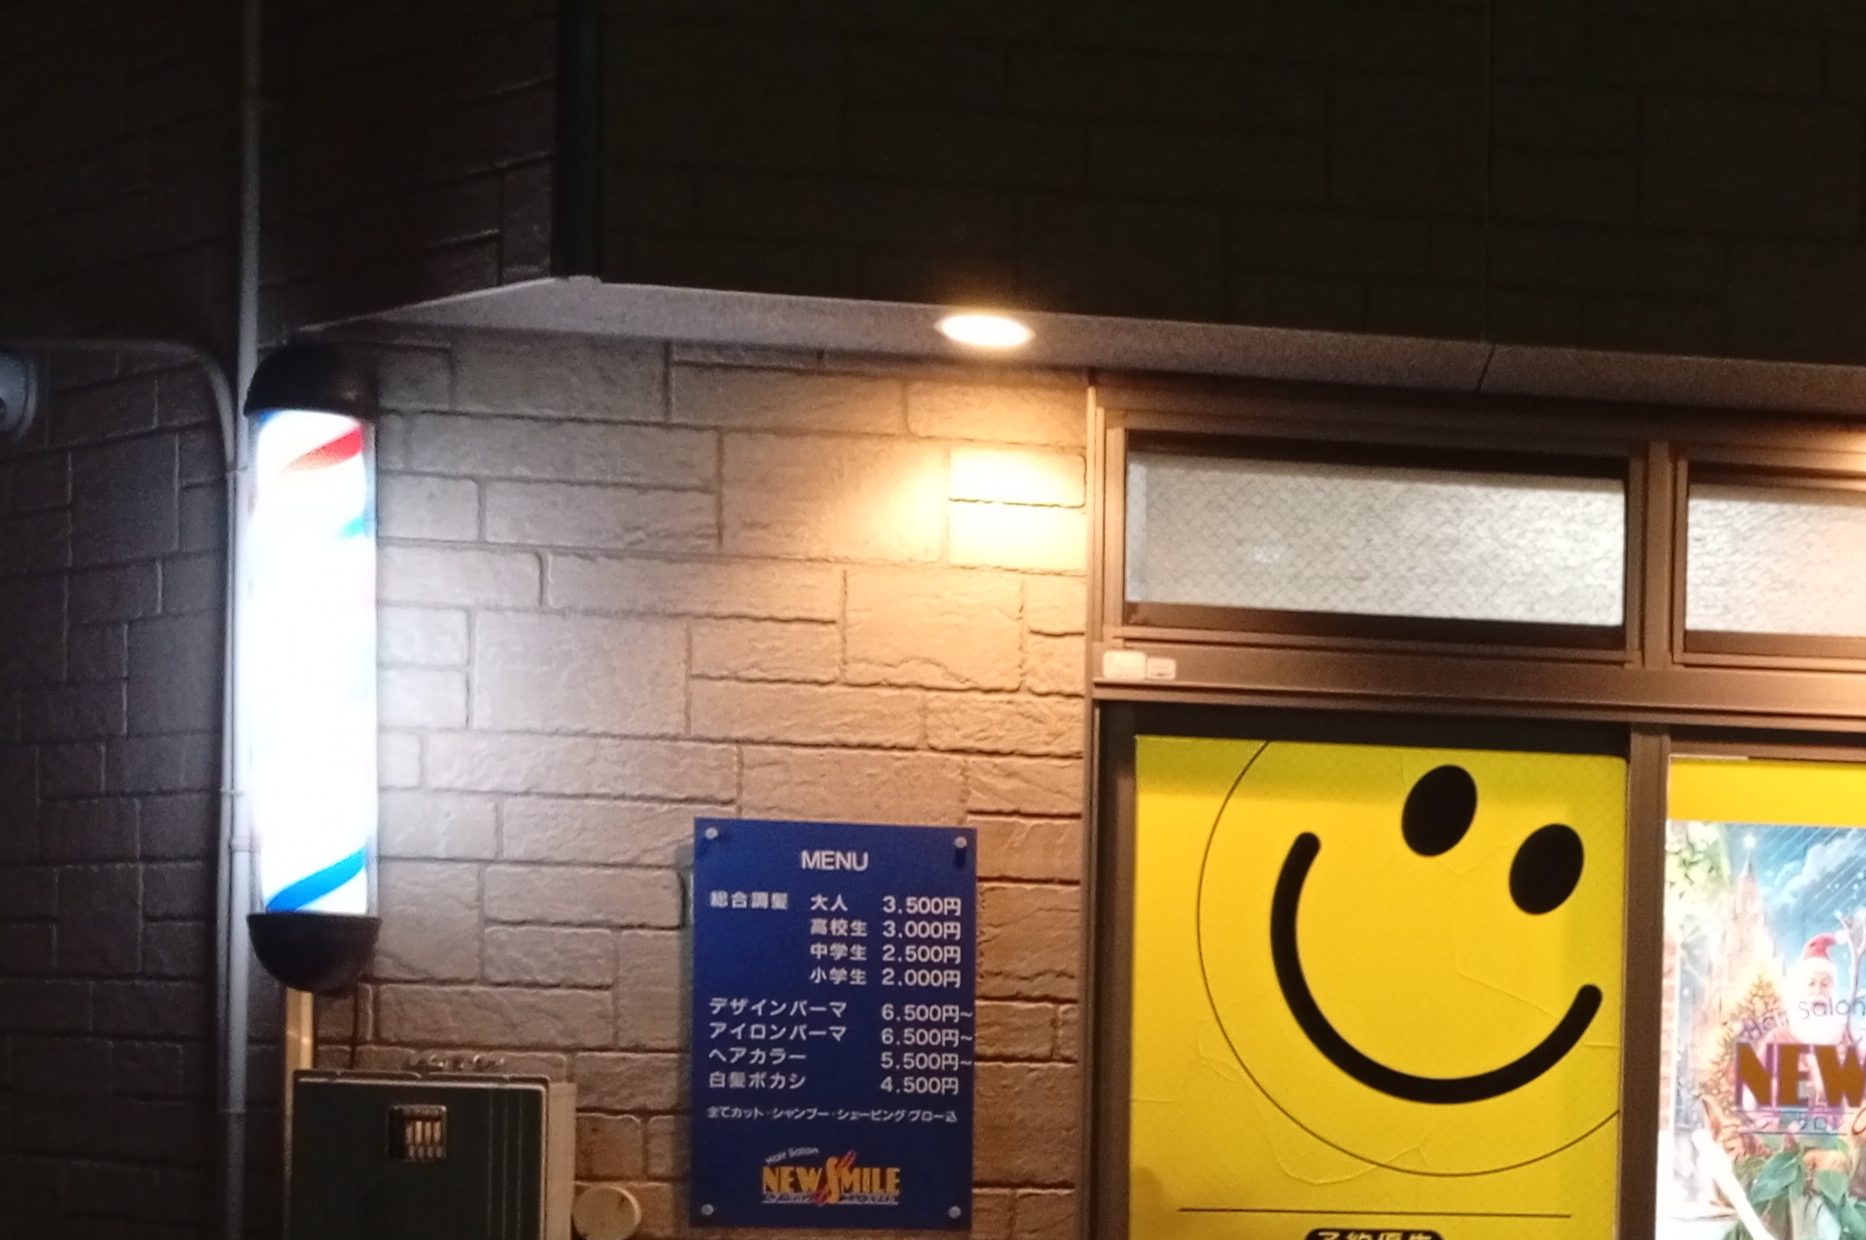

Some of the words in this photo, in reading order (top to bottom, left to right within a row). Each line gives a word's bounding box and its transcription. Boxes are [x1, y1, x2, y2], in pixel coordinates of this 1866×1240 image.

[801, 850, 869, 871] MENU
[810, 894, 849, 911] 大人
[810, 918, 868, 937] 高校生
[810, 942, 868, 961] 中学生
[809, 966, 867, 985] 小学生
[708, 1047, 807, 1065] ヘアカラー
[762, 1166, 823, 1195] NEW
[825, 1156, 901, 1204] SMILE
